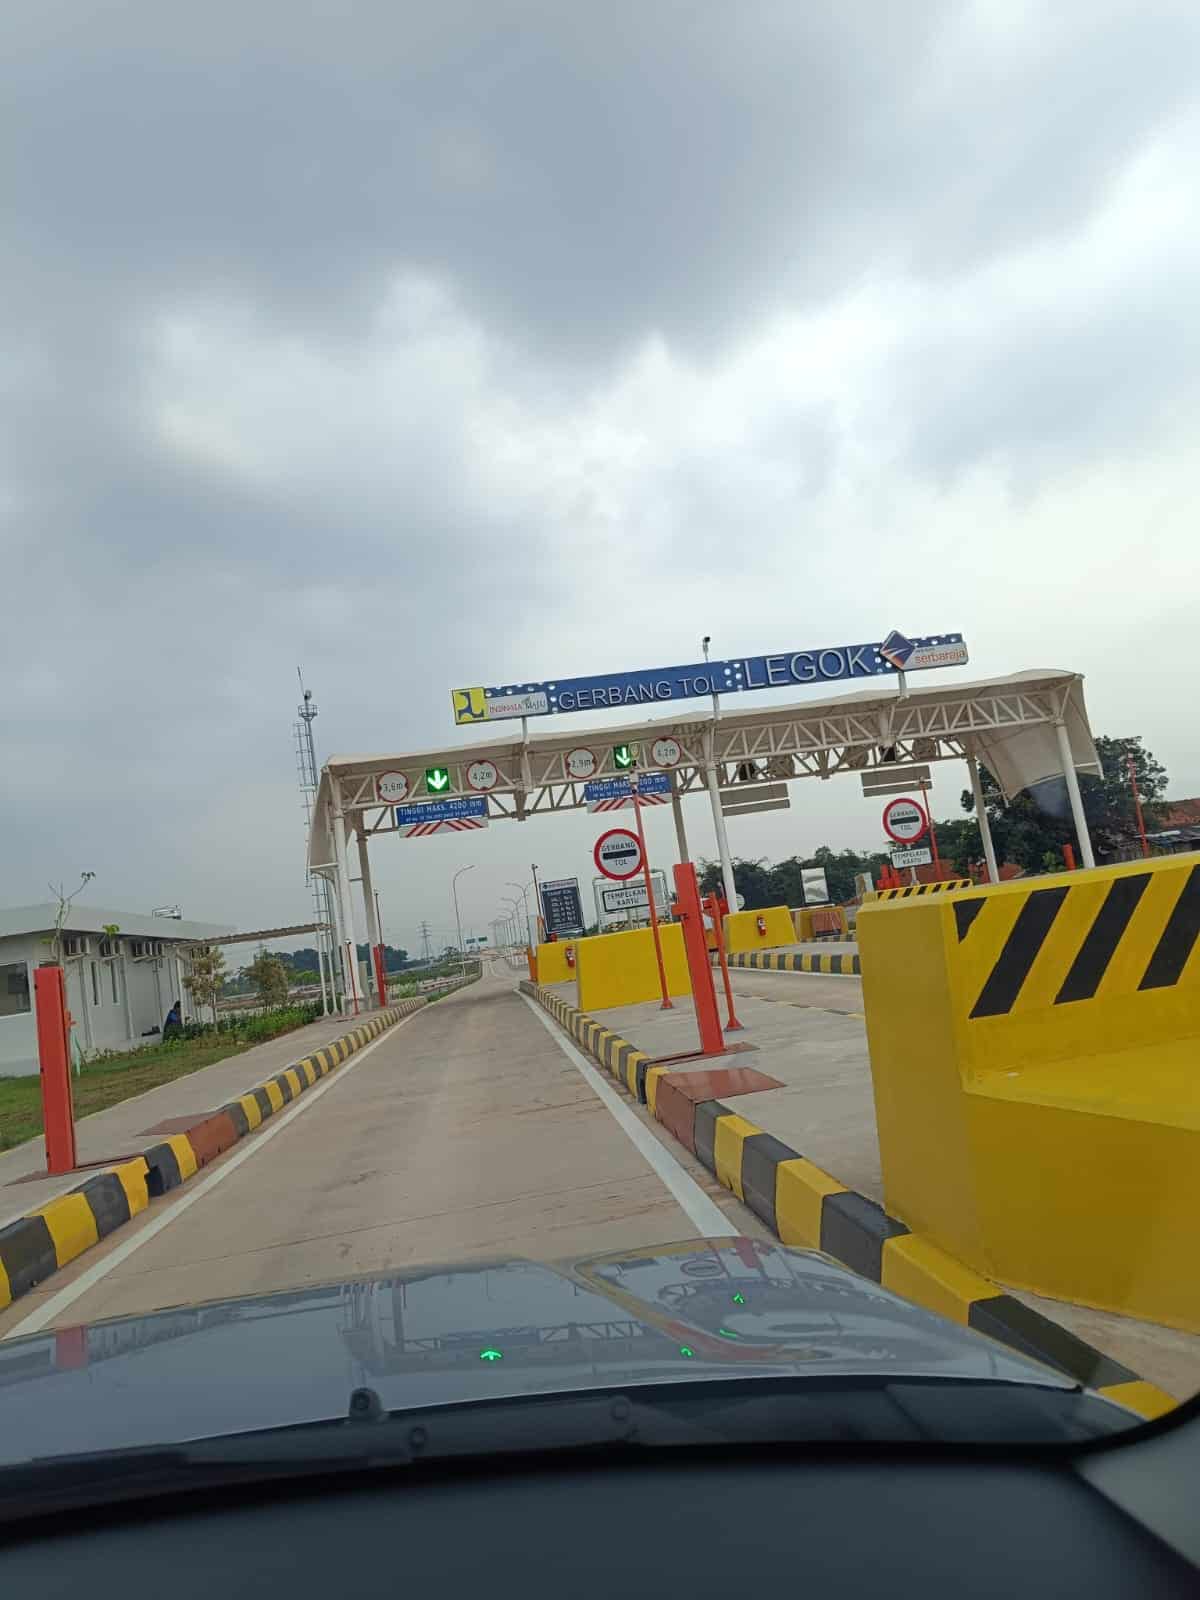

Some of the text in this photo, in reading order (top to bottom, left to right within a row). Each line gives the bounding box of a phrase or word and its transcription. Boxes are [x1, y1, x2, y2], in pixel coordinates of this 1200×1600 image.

[743, 647, 872, 688] LEGOK
[558, 675, 721, 709] GERBANG TOL
[400, 805, 424, 817] TINGGI
[600, 841, 636, 852] GERBANG
[615, 858, 628, 866] TOL
